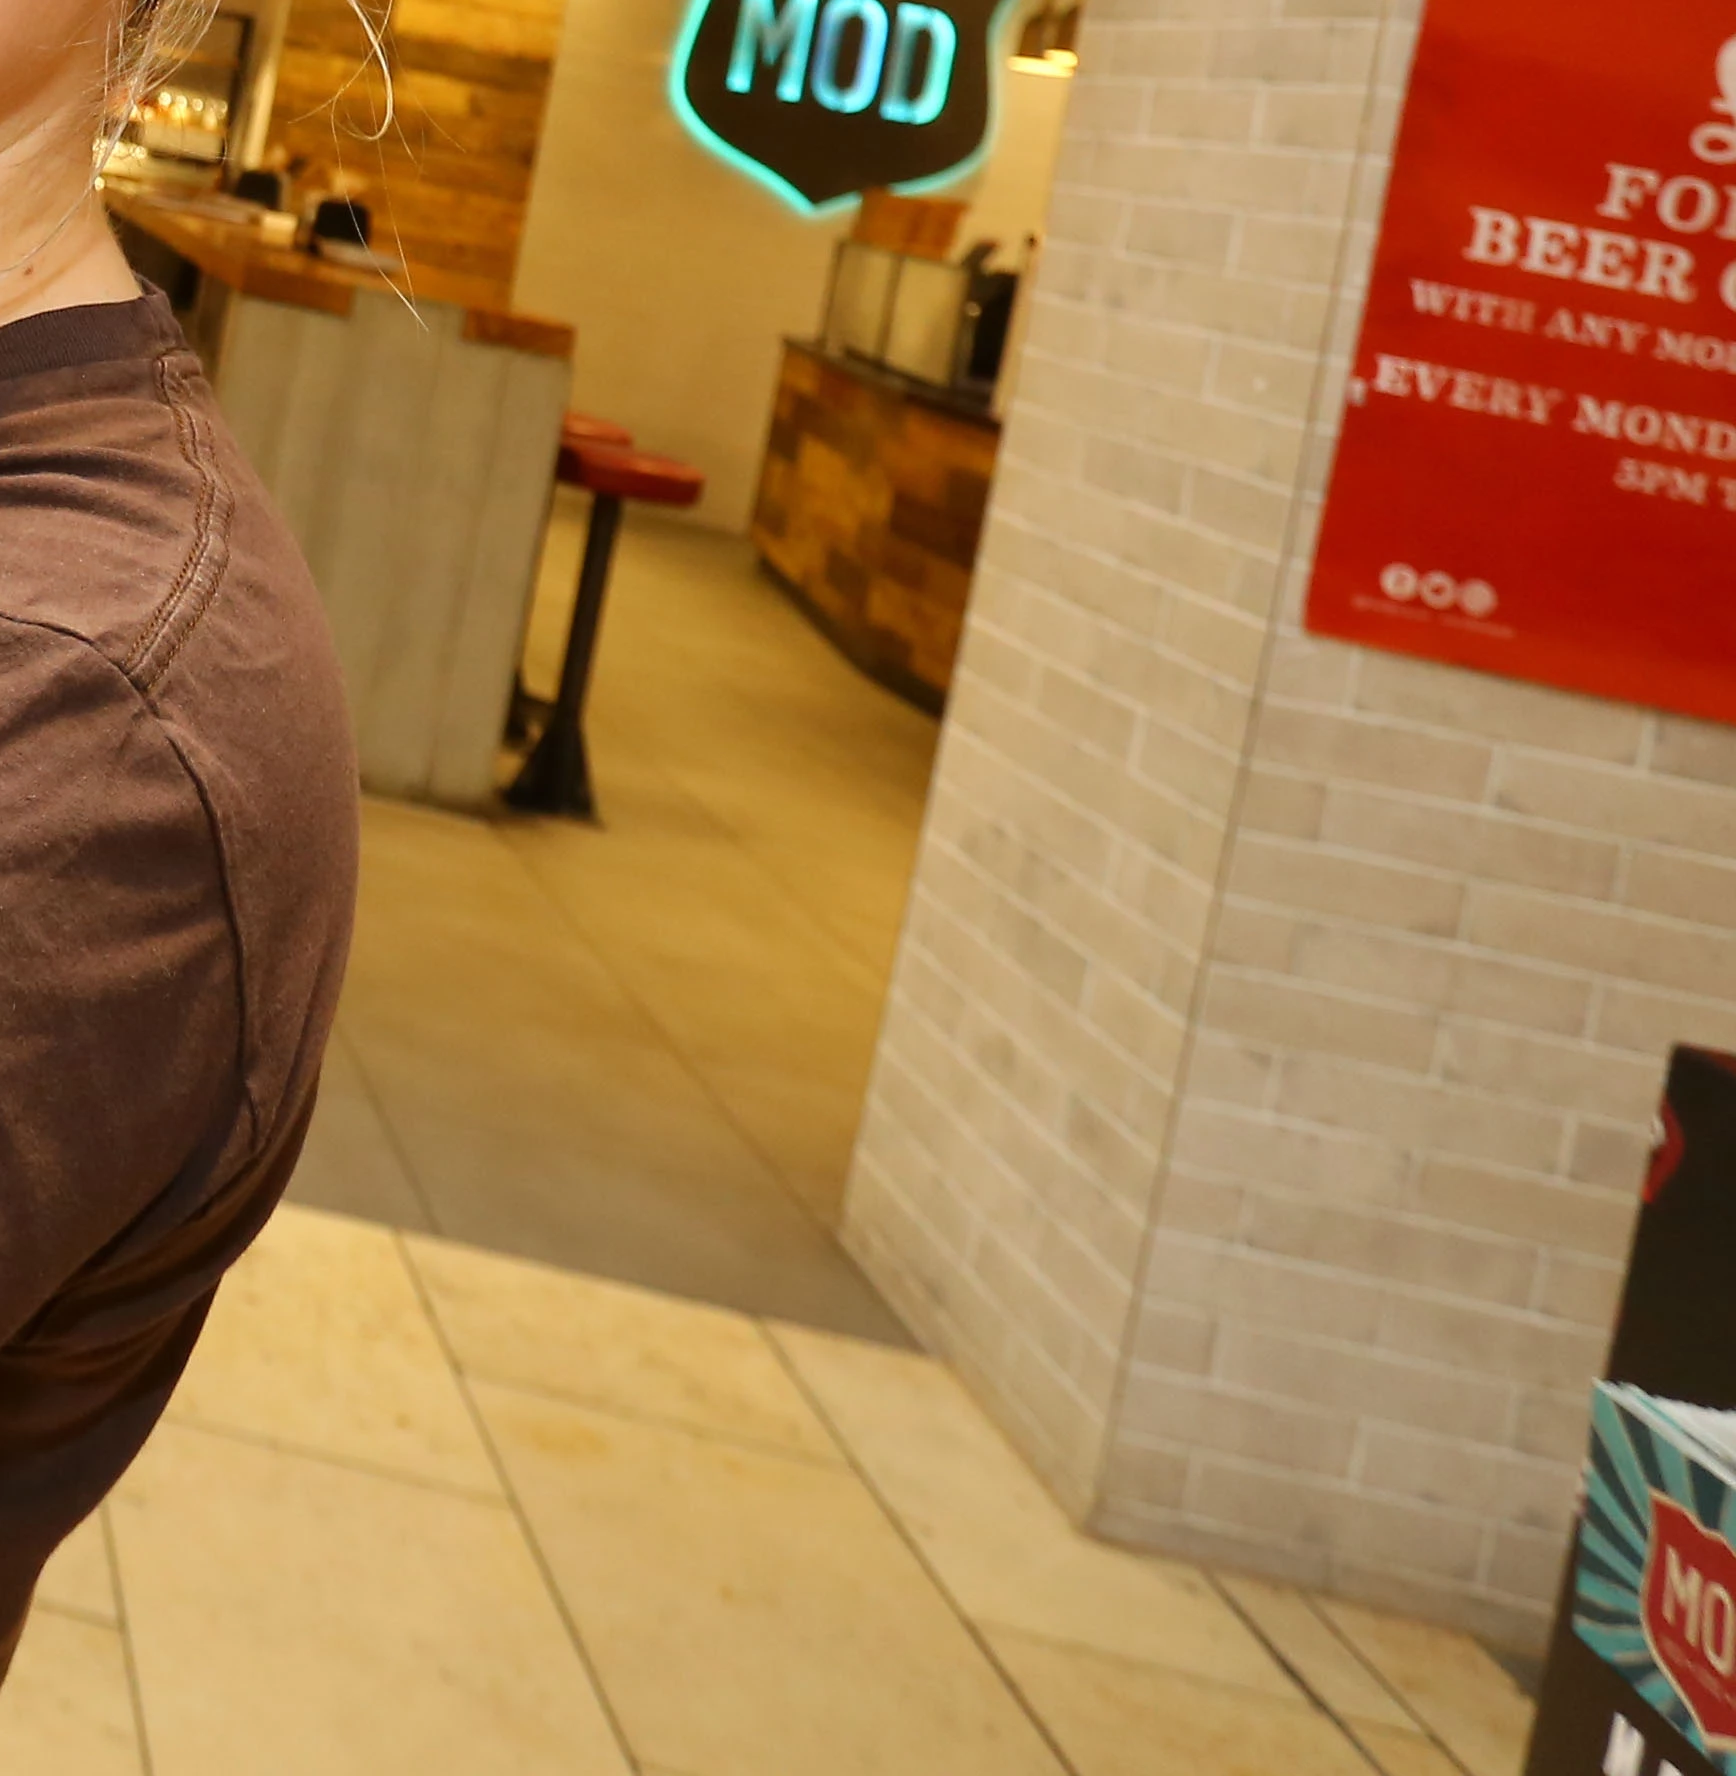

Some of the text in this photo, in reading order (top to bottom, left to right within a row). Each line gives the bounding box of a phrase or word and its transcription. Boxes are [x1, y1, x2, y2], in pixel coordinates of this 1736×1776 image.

[1462, 204, 1698, 304] BEER
[1410, 277, 1536, 334] WITH
[1544, 306, 1650, 357] ANY
[1373, 352, 1567, 427] EVERY
